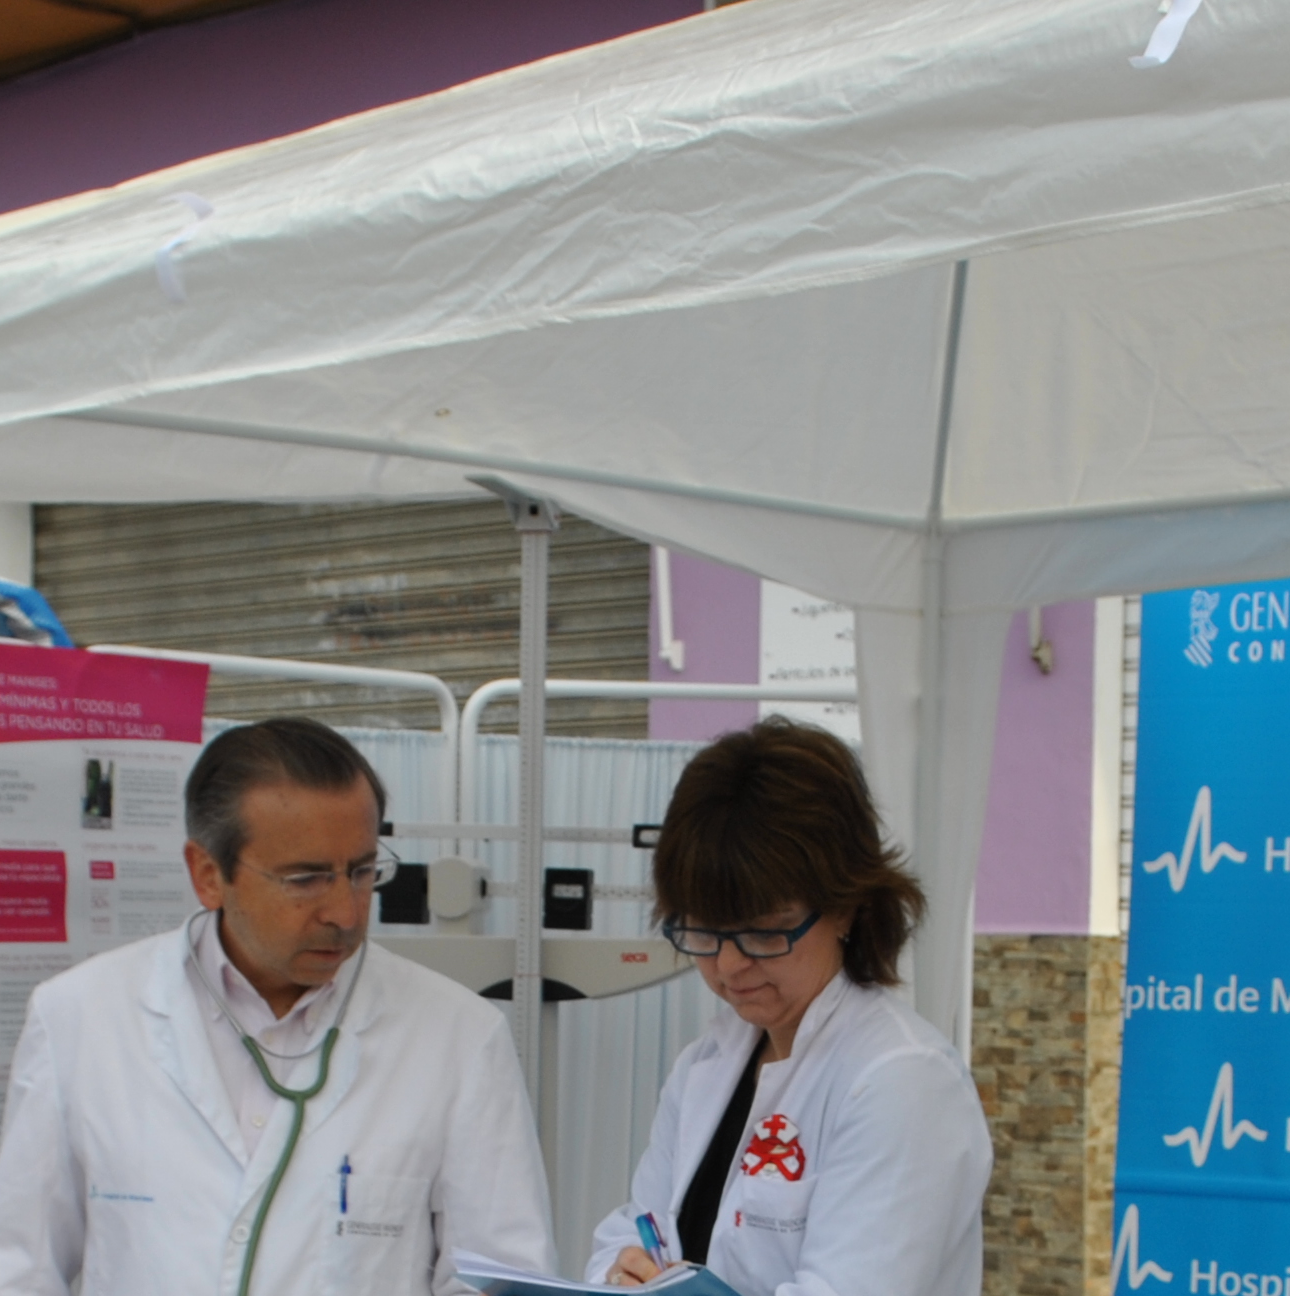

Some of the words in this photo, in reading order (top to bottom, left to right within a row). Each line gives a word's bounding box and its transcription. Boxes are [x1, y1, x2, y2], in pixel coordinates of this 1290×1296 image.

[73, 697, 115, 715] TODOS
[117, 702, 143, 718] LOS
[8, 712, 83, 733] PENSANDO
[87, 718, 105, 735] EN
[621, 951, 649, 963] seca
[1213, 974, 1260, 1013] de
